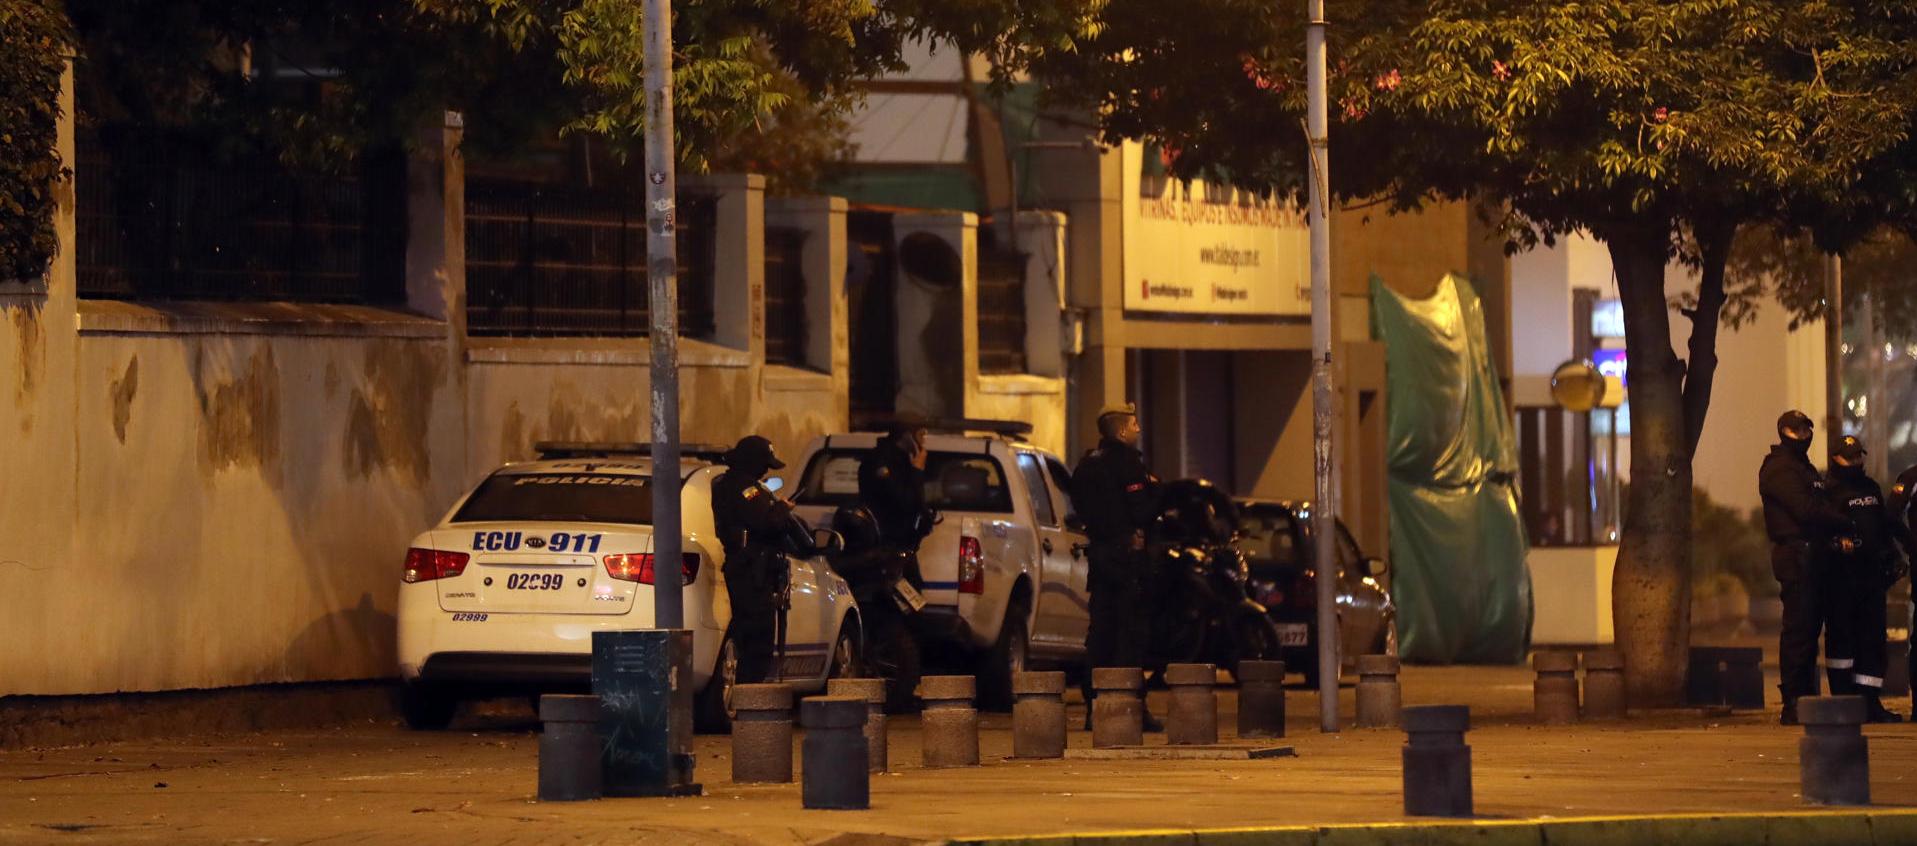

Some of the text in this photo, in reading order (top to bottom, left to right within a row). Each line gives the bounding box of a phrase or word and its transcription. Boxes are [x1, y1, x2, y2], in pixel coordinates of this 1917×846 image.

[514, 476, 645, 488] POLICIA
[472, 531, 602, 553] ECU 911
[452, 612, 488, 622] 02999
